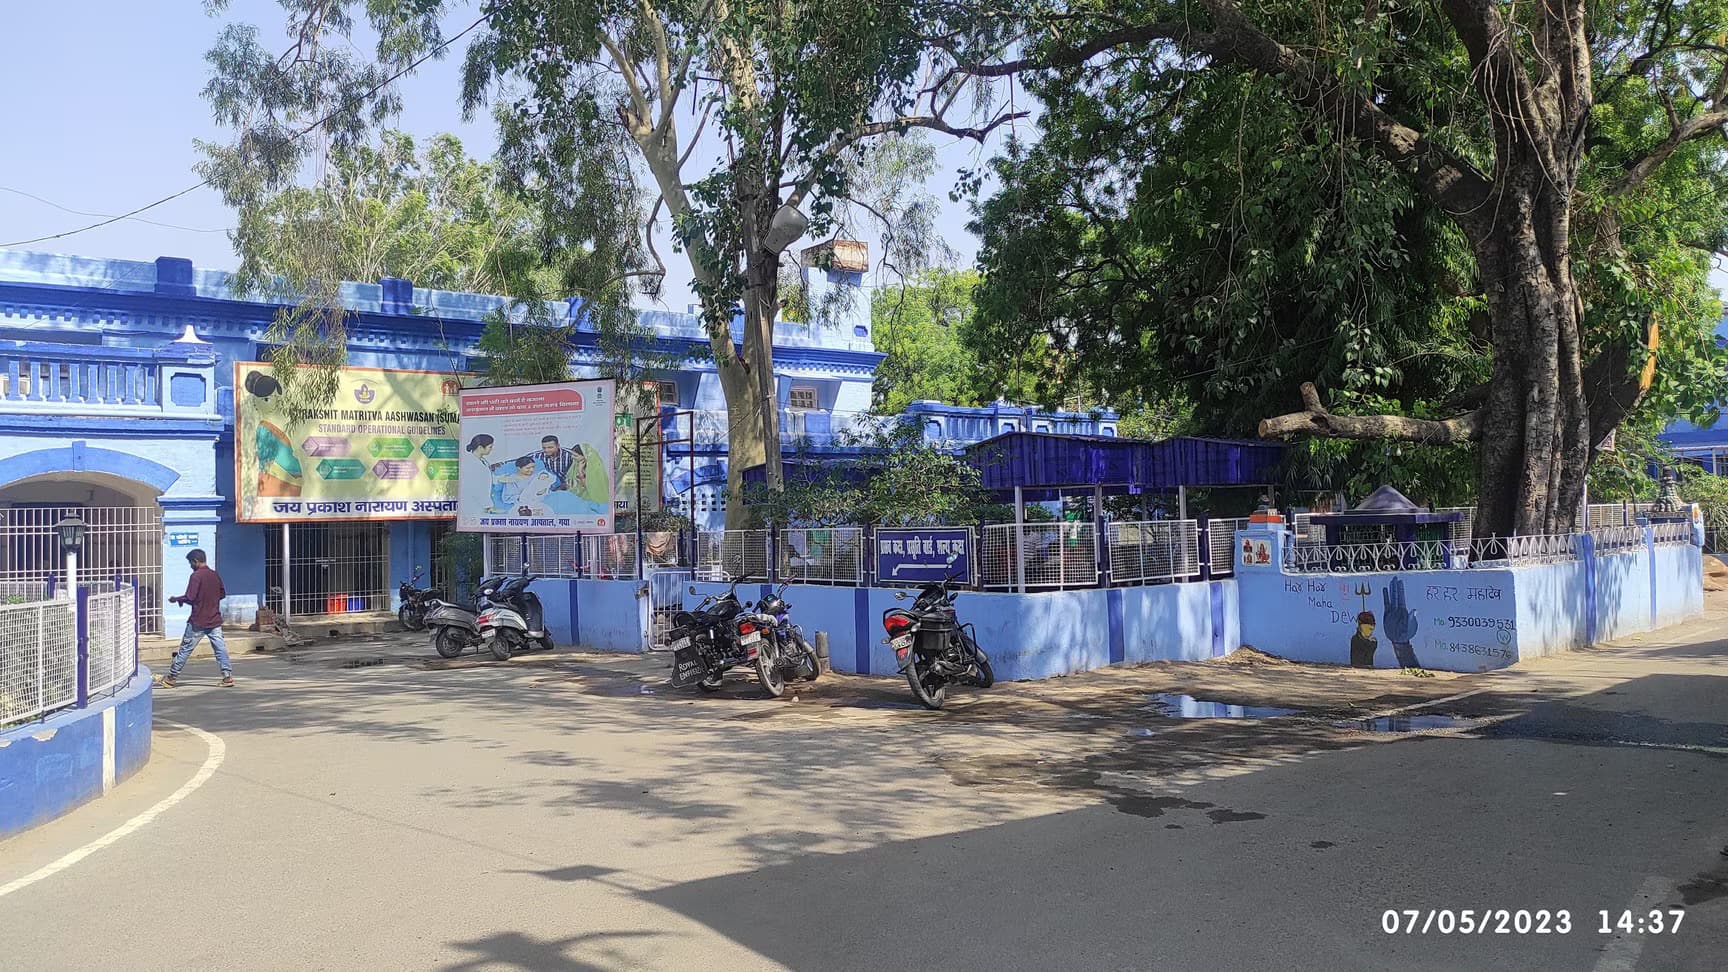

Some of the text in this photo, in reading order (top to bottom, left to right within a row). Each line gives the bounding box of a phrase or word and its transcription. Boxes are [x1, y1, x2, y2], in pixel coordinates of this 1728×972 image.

[341, 409, 383, 421] MATRITVA
[385, 411, 434, 422] AASHWASAN
[318, 424, 445, 436] STANDARD OPERATIONAL GUIDELINES
[273, 502, 302, 513] जय
[306, 501, 351, 516] प्रकाश
[355, 501, 407, 512] नारायण
[411, 500, 458, 512] अस्पता
[1284, 579, 1303, 593] Har
[1307, 578, 1327, 592] Har
[1425, 585, 1441, 600] हर
[1466, 585, 1502, 601] महादेव
[1308, 596, 1333, 608] Maha
